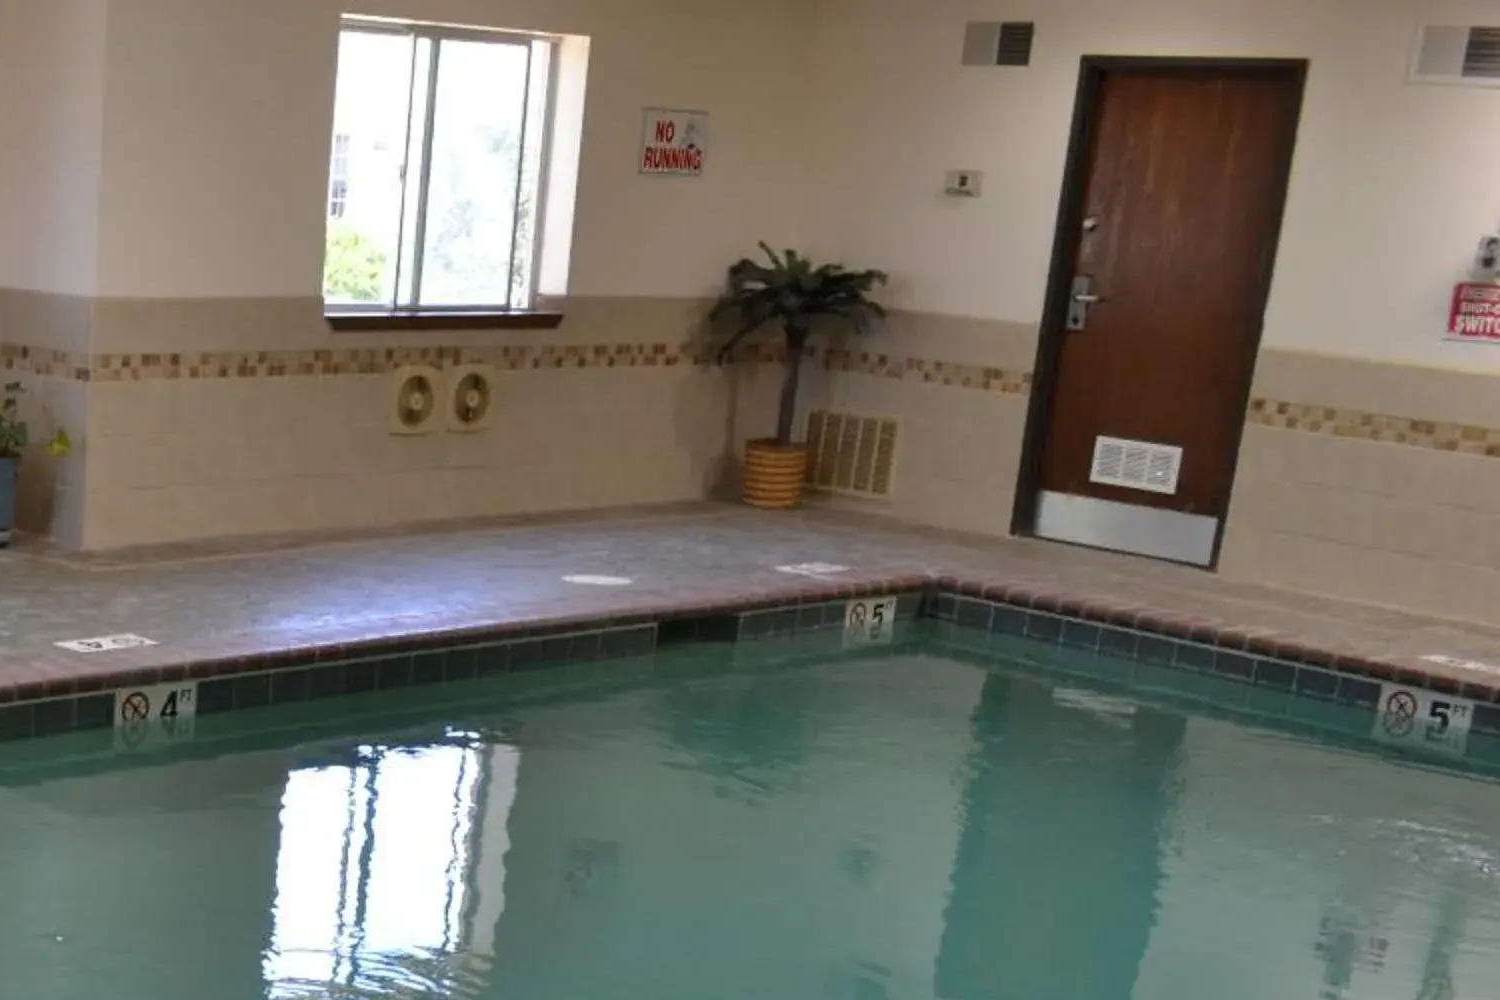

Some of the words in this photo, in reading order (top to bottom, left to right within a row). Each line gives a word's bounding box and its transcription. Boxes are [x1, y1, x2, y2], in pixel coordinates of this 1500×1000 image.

[656, 119, 675, 144] NO
[643, 146, 703, 170] RUNNING
[872, 603, 885, 623] 5
[159, 690, 179, 717] 4
[1429, 701, 1451, 731] 5
